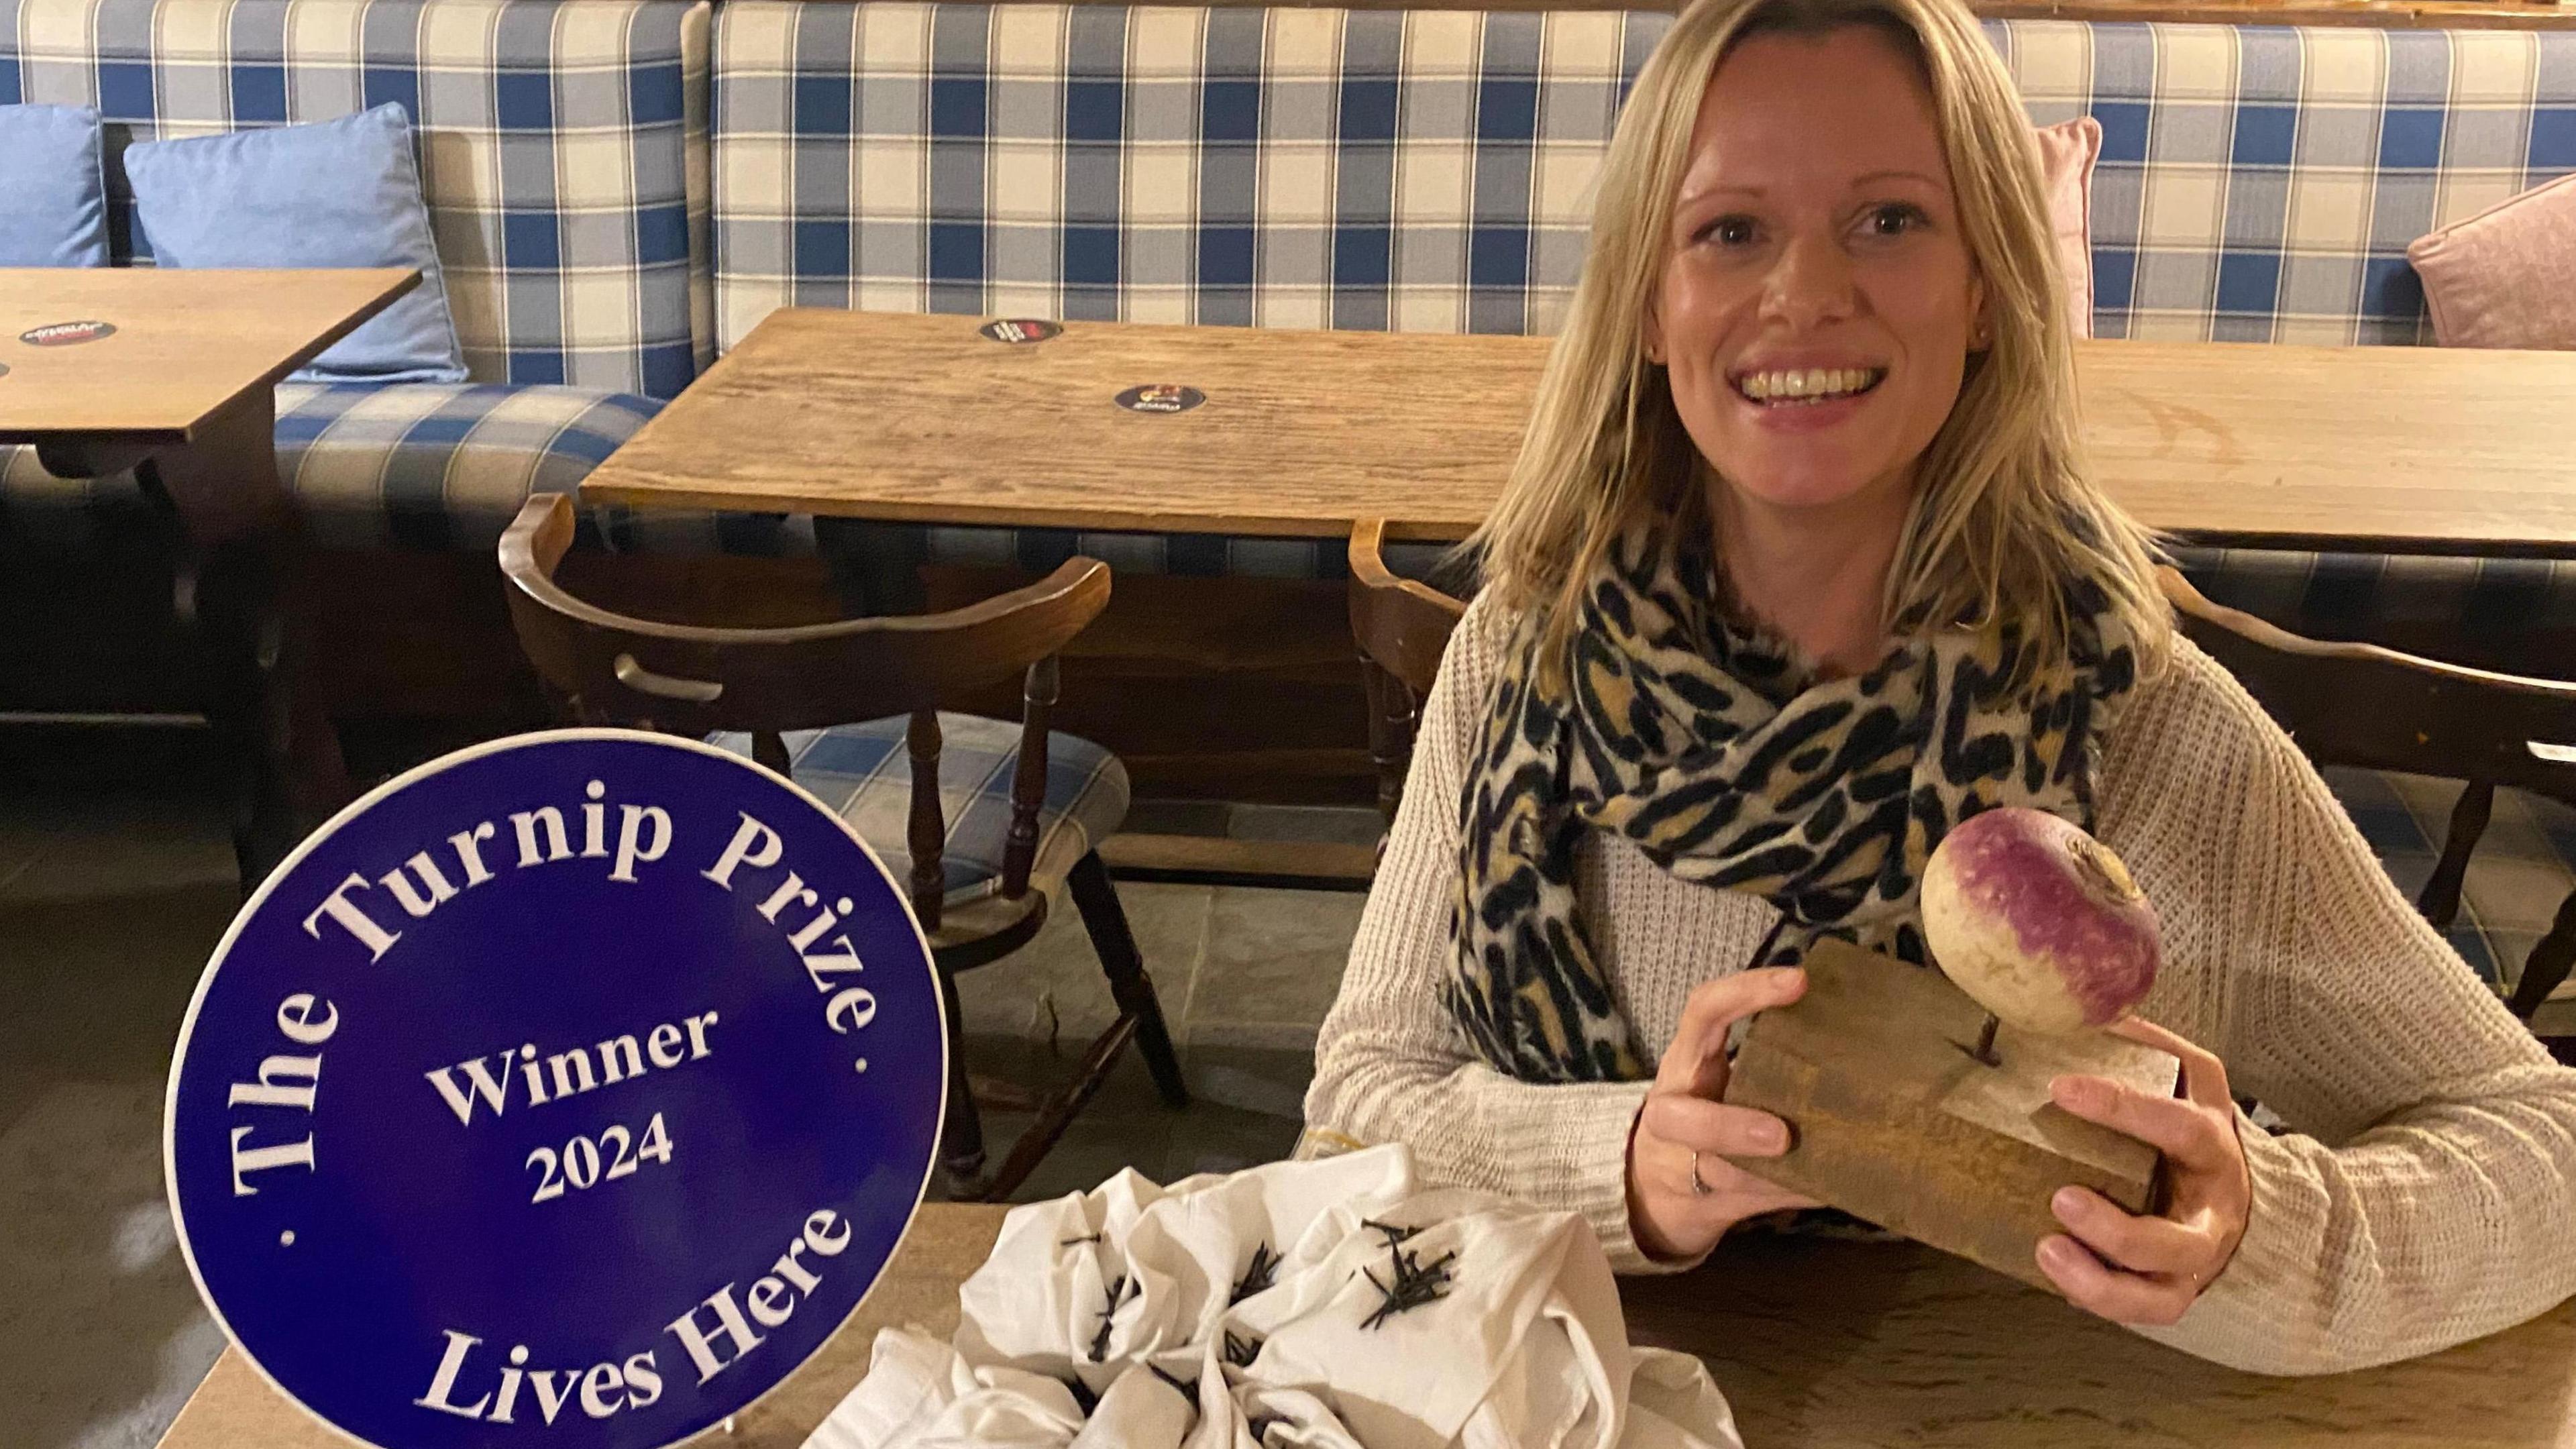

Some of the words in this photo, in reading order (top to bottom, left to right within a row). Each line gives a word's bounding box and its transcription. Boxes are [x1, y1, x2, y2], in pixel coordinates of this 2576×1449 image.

[228, 993, 339, 1195] The
[303, 780, 673, 963] Turnip
[701, 811, 877, 1034] Prize
[426, 1011, 718, 1126] Winner
[525, 1112, 674, 1203] 2024
[415, 1330, 663, 1426] Lives
[663, 1208, 852, 1385] Here
